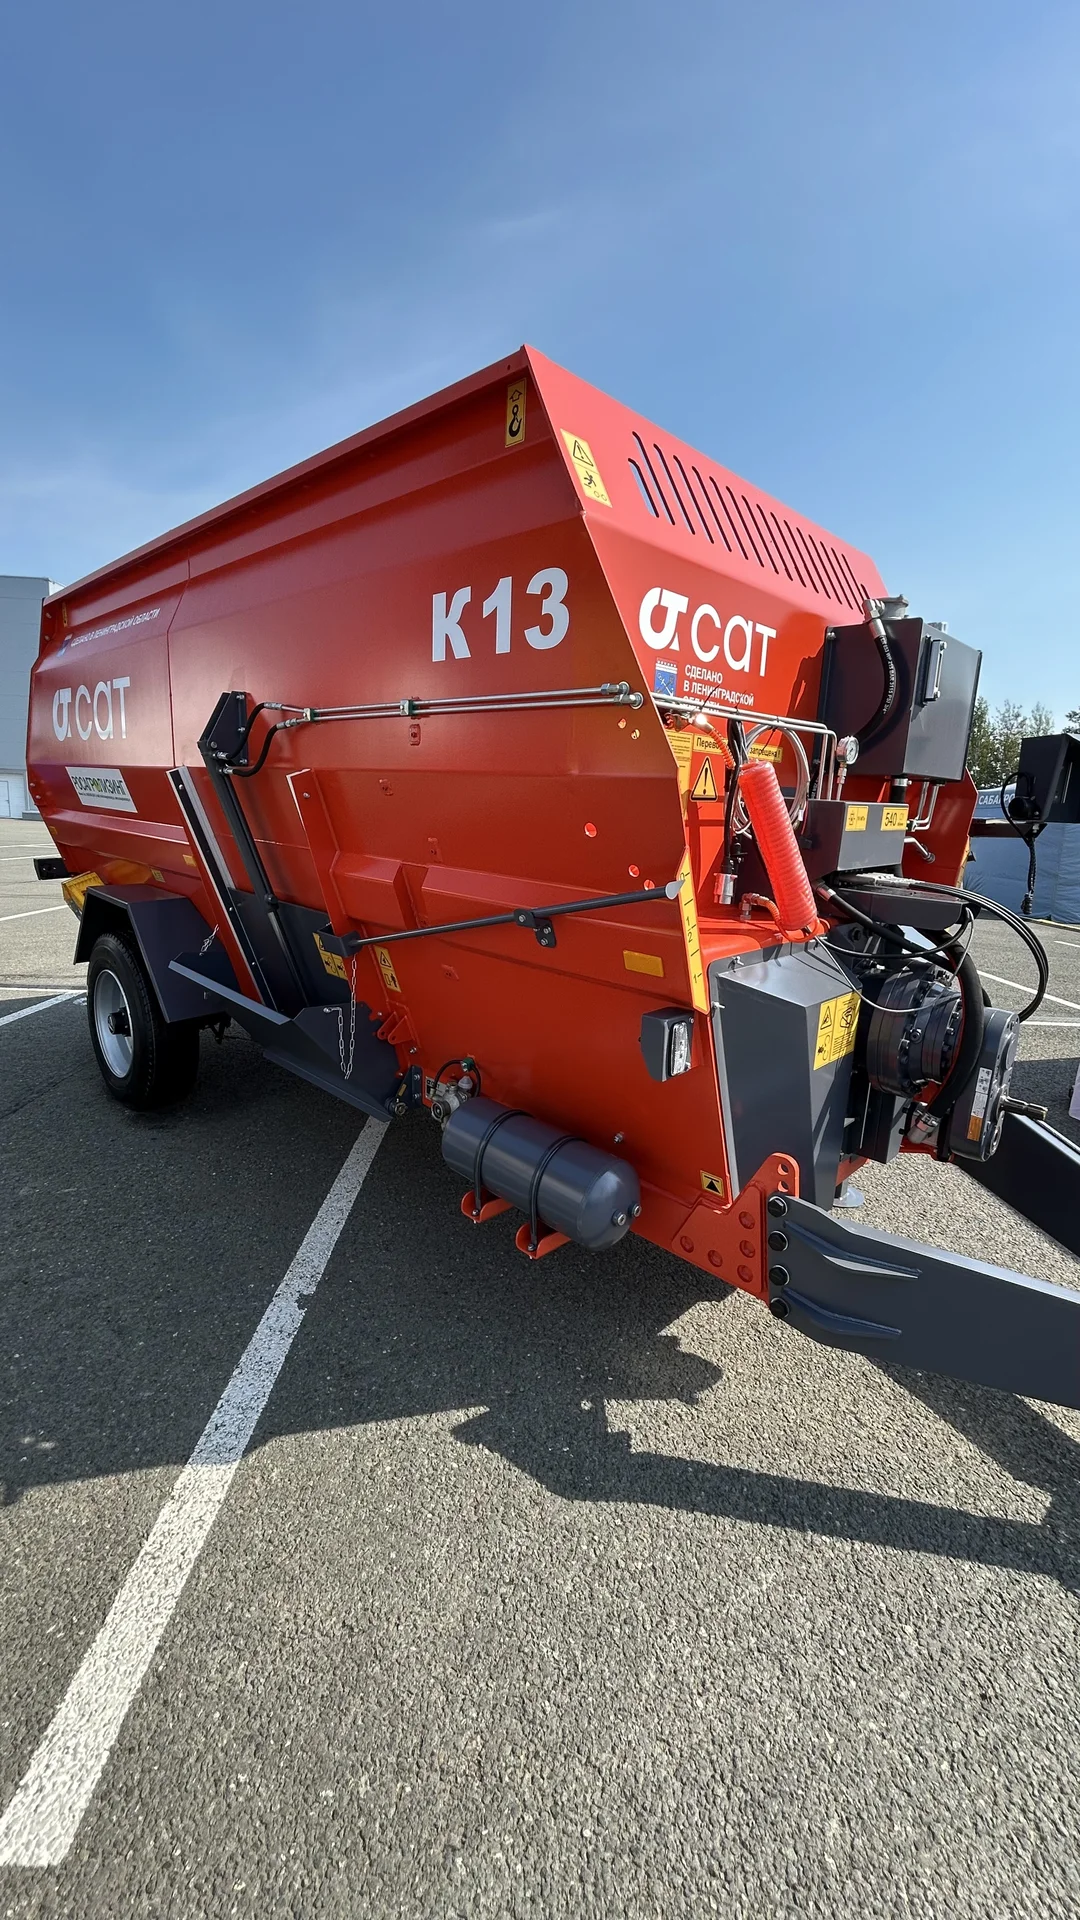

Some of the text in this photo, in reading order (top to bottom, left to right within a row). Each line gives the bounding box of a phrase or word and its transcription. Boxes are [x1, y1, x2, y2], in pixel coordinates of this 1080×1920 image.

[684, 664, 723, 684] СДЕЛАНО
[683, 680, 754, 706] В ЛЕНИНГРАДСКОЙ
[884, 812, 898, 827] 540
